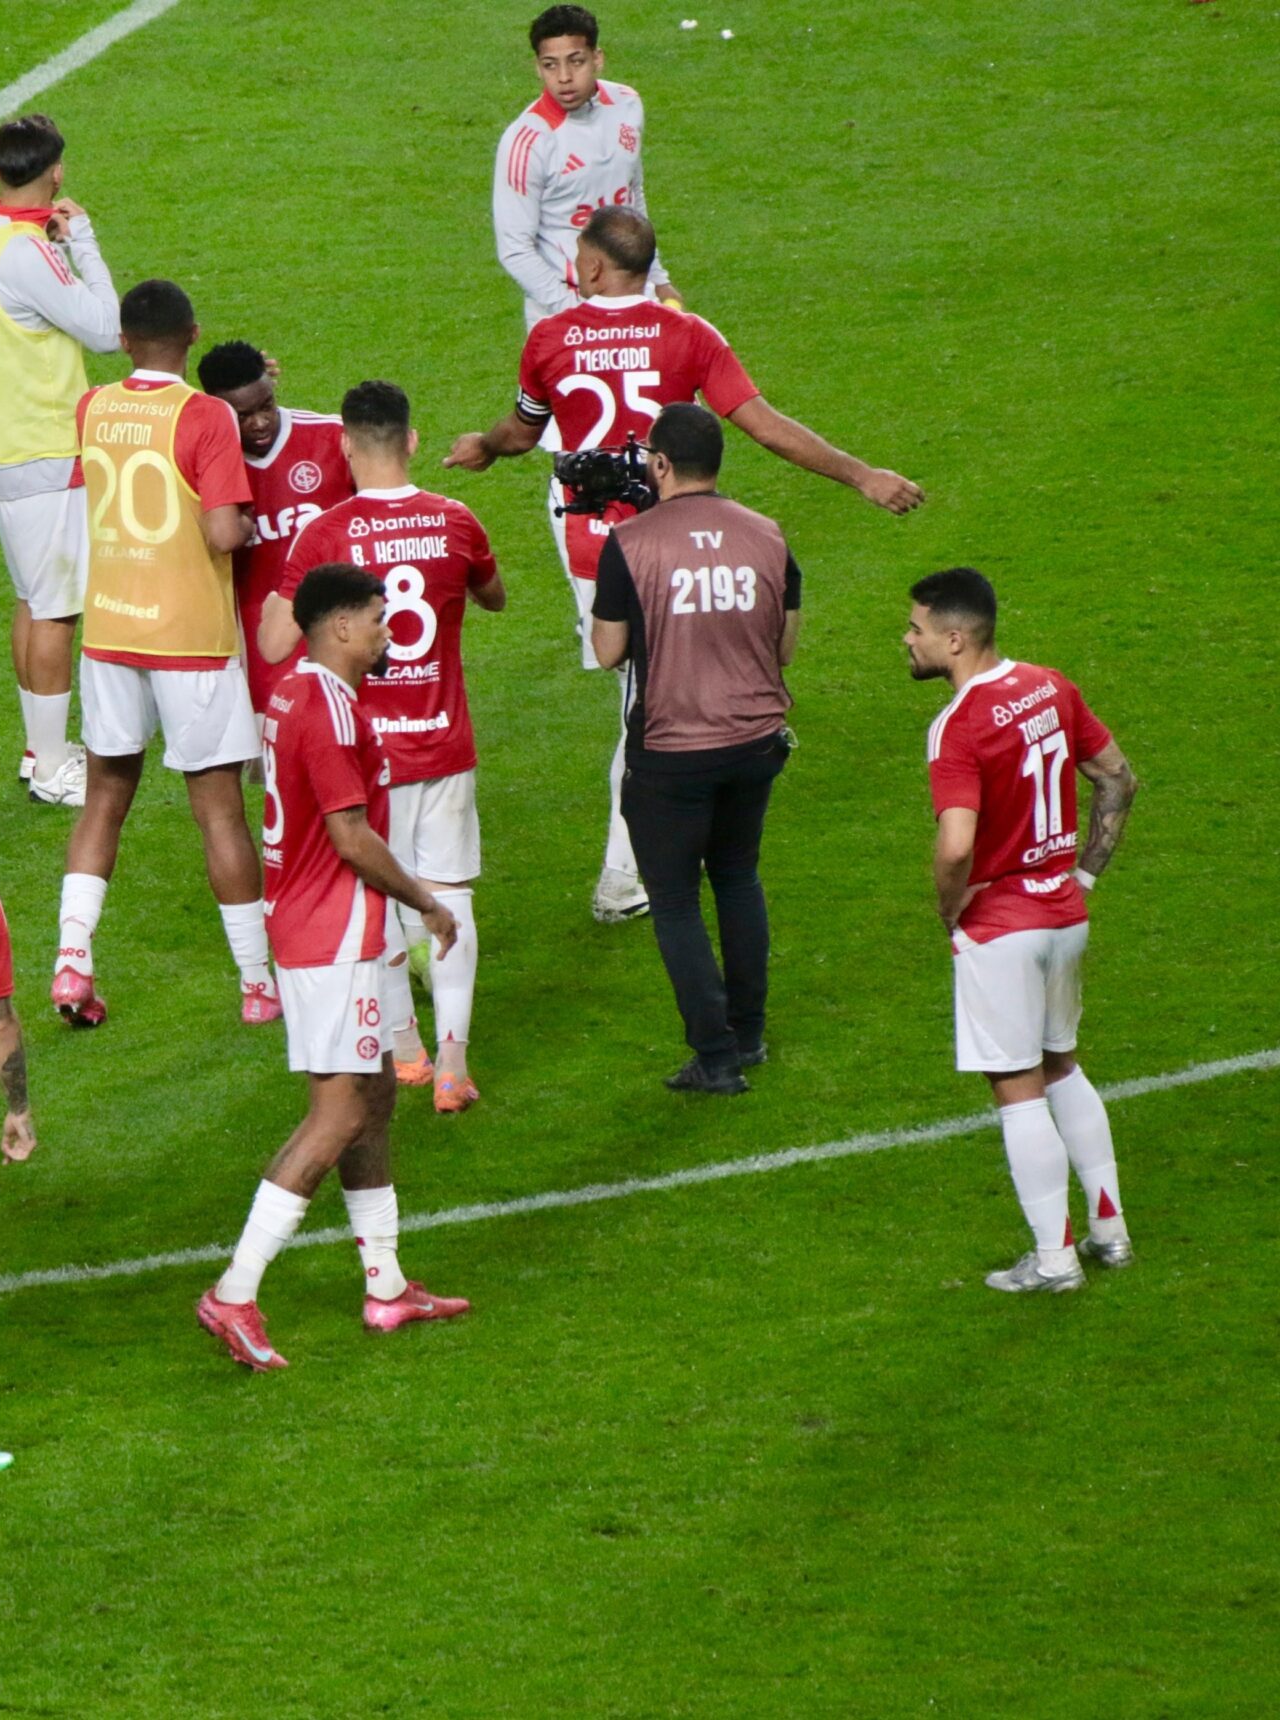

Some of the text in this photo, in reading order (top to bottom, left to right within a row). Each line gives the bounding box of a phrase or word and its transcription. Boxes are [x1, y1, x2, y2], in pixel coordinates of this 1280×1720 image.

[586, 323, 660, 341] banrisul
[575, 347, 650, 372] MERCADO
[108, 400, 176, 417] banrisul
[556, 371, 661, 451] 25
[96, 422, 152, 446] CLAYTON
[84, 446, 181, 544] 20
[371, 512, 446, 532] banrisul
[351, 536, 449, 566] B. HENRIQUE
[689, 531, 723, 549] TV
[671, 565, 757, 615] 2193
[93, 592, 160, 619] Unimed
[384, 564, 438, 661] 8
[366, 661, 440, 680] GAME
[1008, 680, 1058, 715] banrisul
[372, 711, 449, 733] Unimed
[1018, 706, 1060, 745] TABATA
[1022, 730, 1069, 844] 17
[355, 997, 381, 1027] 18
